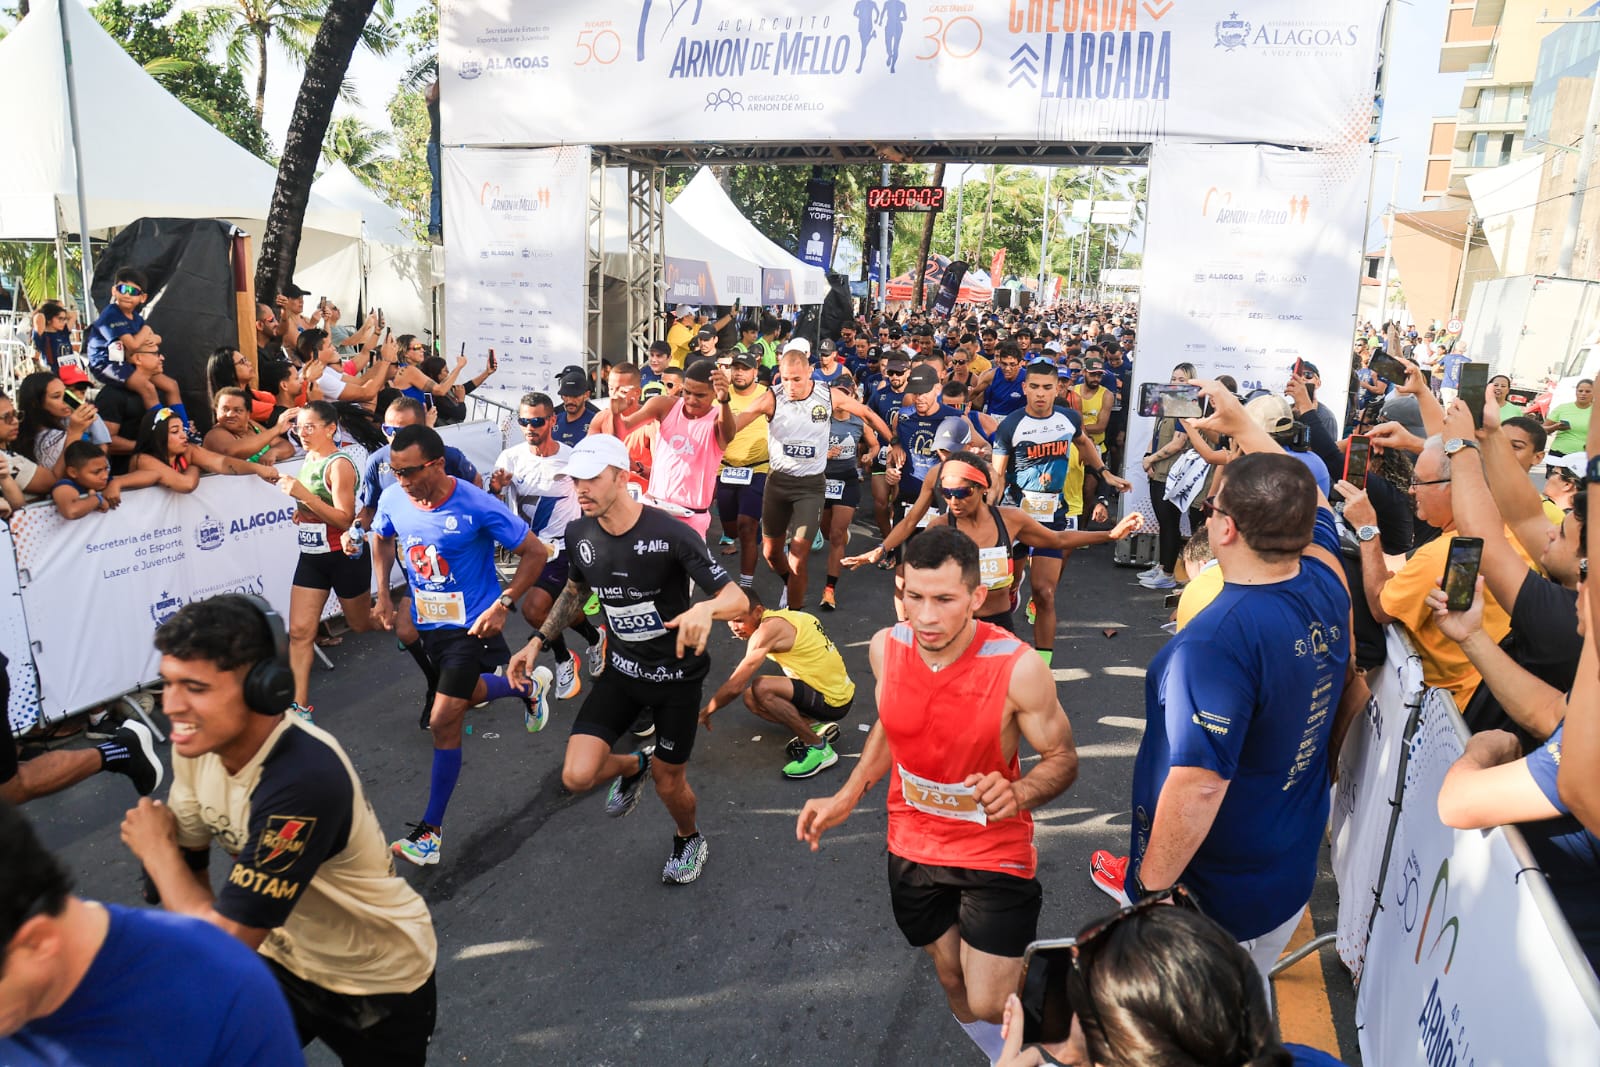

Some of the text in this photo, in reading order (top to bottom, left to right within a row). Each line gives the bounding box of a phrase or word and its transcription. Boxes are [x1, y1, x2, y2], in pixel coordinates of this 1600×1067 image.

[736, 15, 830, 32] CIRCUITO
[915, 15, 983, 60] 30
[1252, 24, 1359, 46] ALAGOAS
[575, 29, 622, 66] 50
[669, 32, 851, 78] ARNON DE MELLO
[486, 56, 549, 70] ALAGOAS
[1040, 31, 1171, 99] LARGADA
[747, 102, 825, 112] ARNON DE MELLO
[868, 188, 943, 207] 00:00:02
[809, 212, 832, 221] YOPP
[1216, 208, 1248, 224] ARNON
[1257, 209, 1288, 224] MELLO
[1208, 273, 1244, 281] ALAGOAS
[786, 445, 813, 456] 2783
[1027, 440, 1069, 459] MUTUM
[1029, 501, 1048, 511] 526
[229, 507, 294, 534] ALAGOAS
[86, 525, 182, 553] Secretaria de Estado
[134, 539, 184, 557] do Esporte
[647, 540, 669, 552] Alfa
[103, 552, 186, 579] Lazer e Juventude
[604, 587, 622, 595] MCI
[423, 602, 448, 616] 196
[614, 613, 656, 630] 2503
[917, 788, 959, 808] 734
[261, 832, 304, 853] ROTAM
[229, 863, 299, 900] ROTAM
